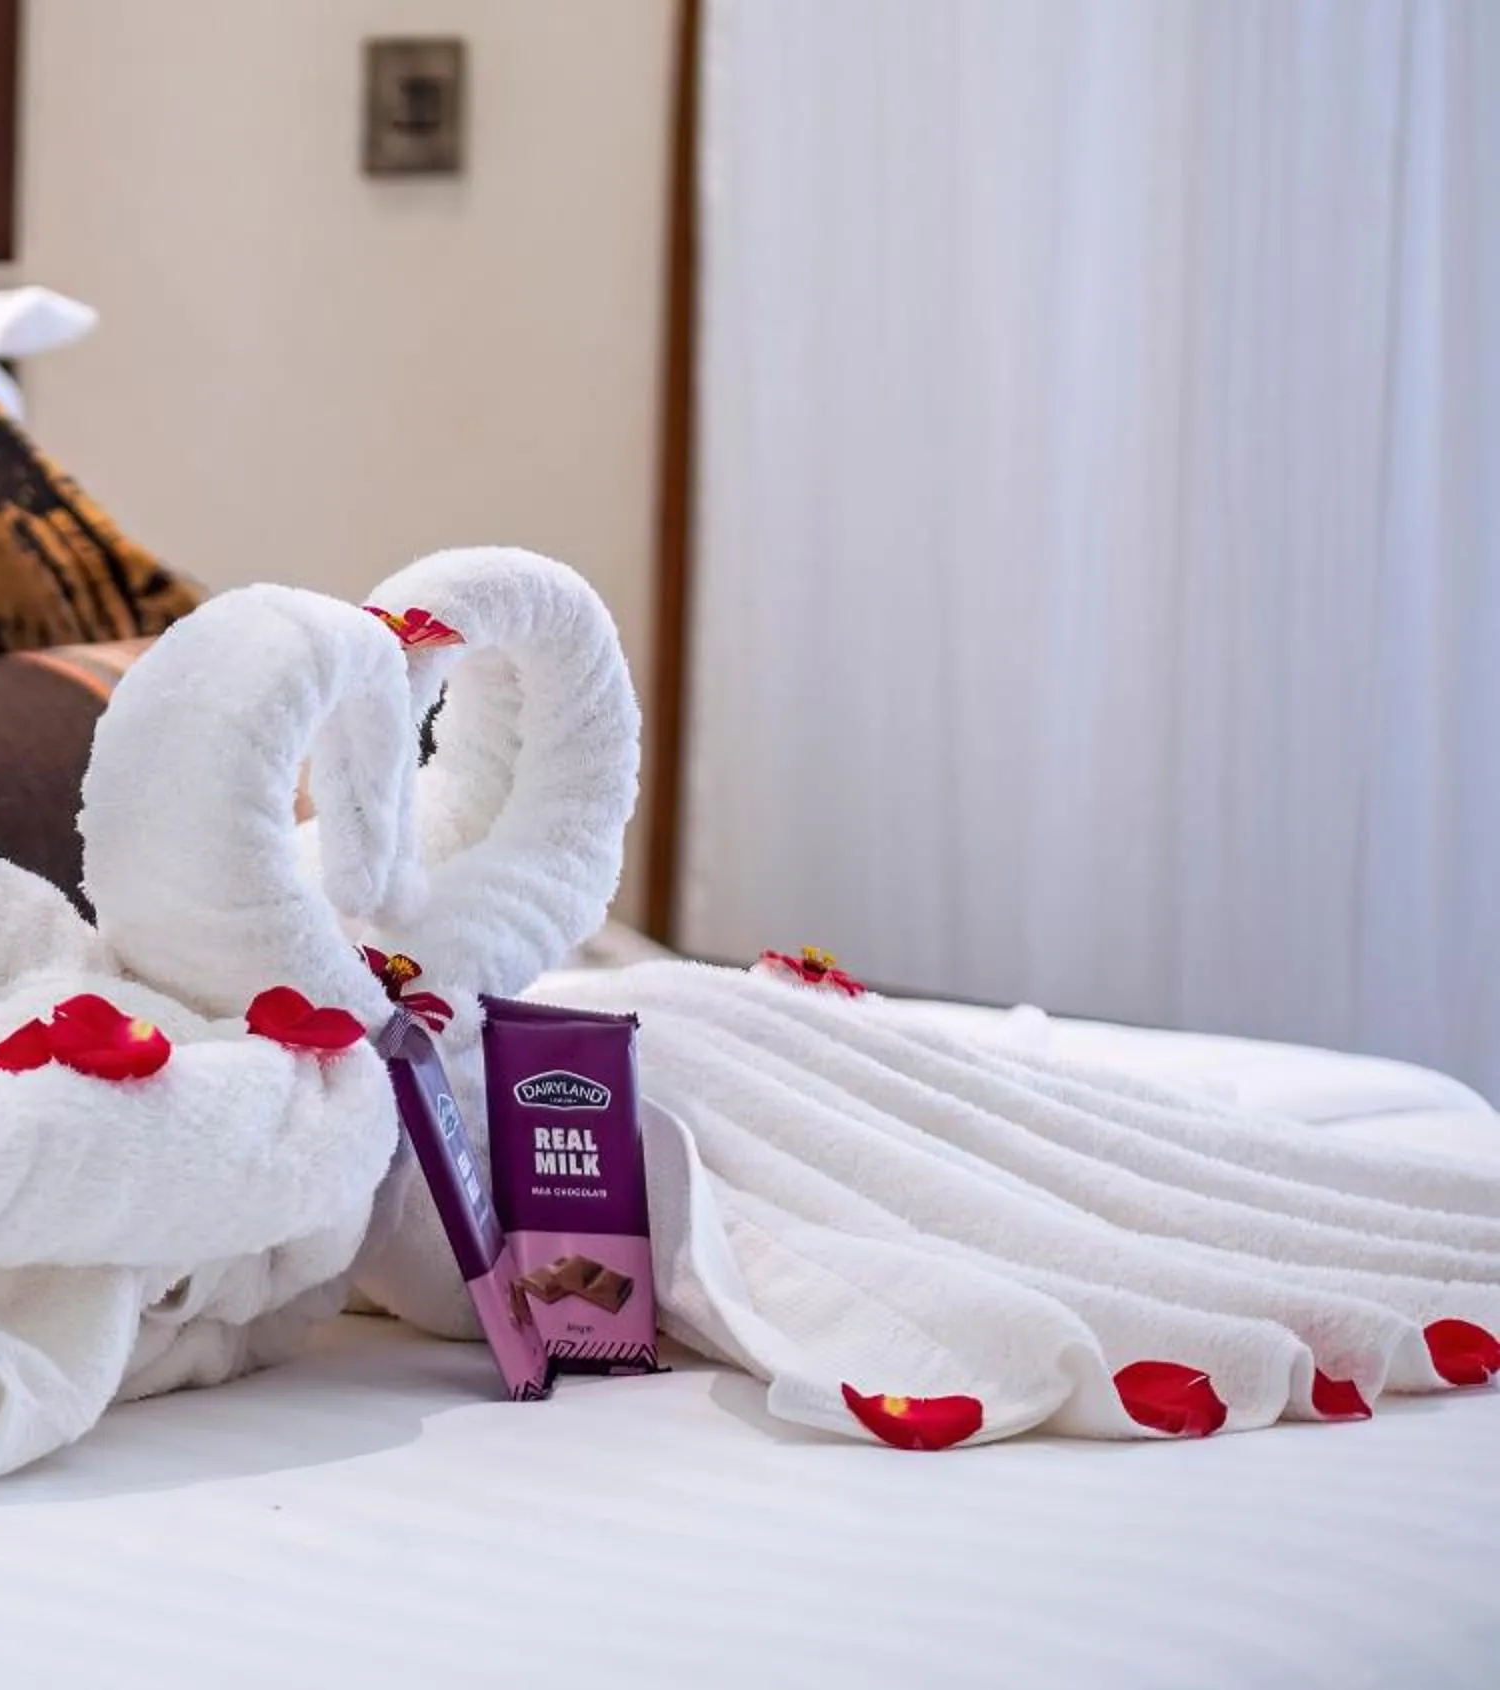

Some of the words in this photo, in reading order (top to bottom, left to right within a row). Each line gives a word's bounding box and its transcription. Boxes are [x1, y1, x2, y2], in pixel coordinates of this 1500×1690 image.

[521, 1081, 603, 1103] DAIRYLAND
[535, 1127, 598, 1151] REAL
[535, 1151, 601, 1176] MILK
